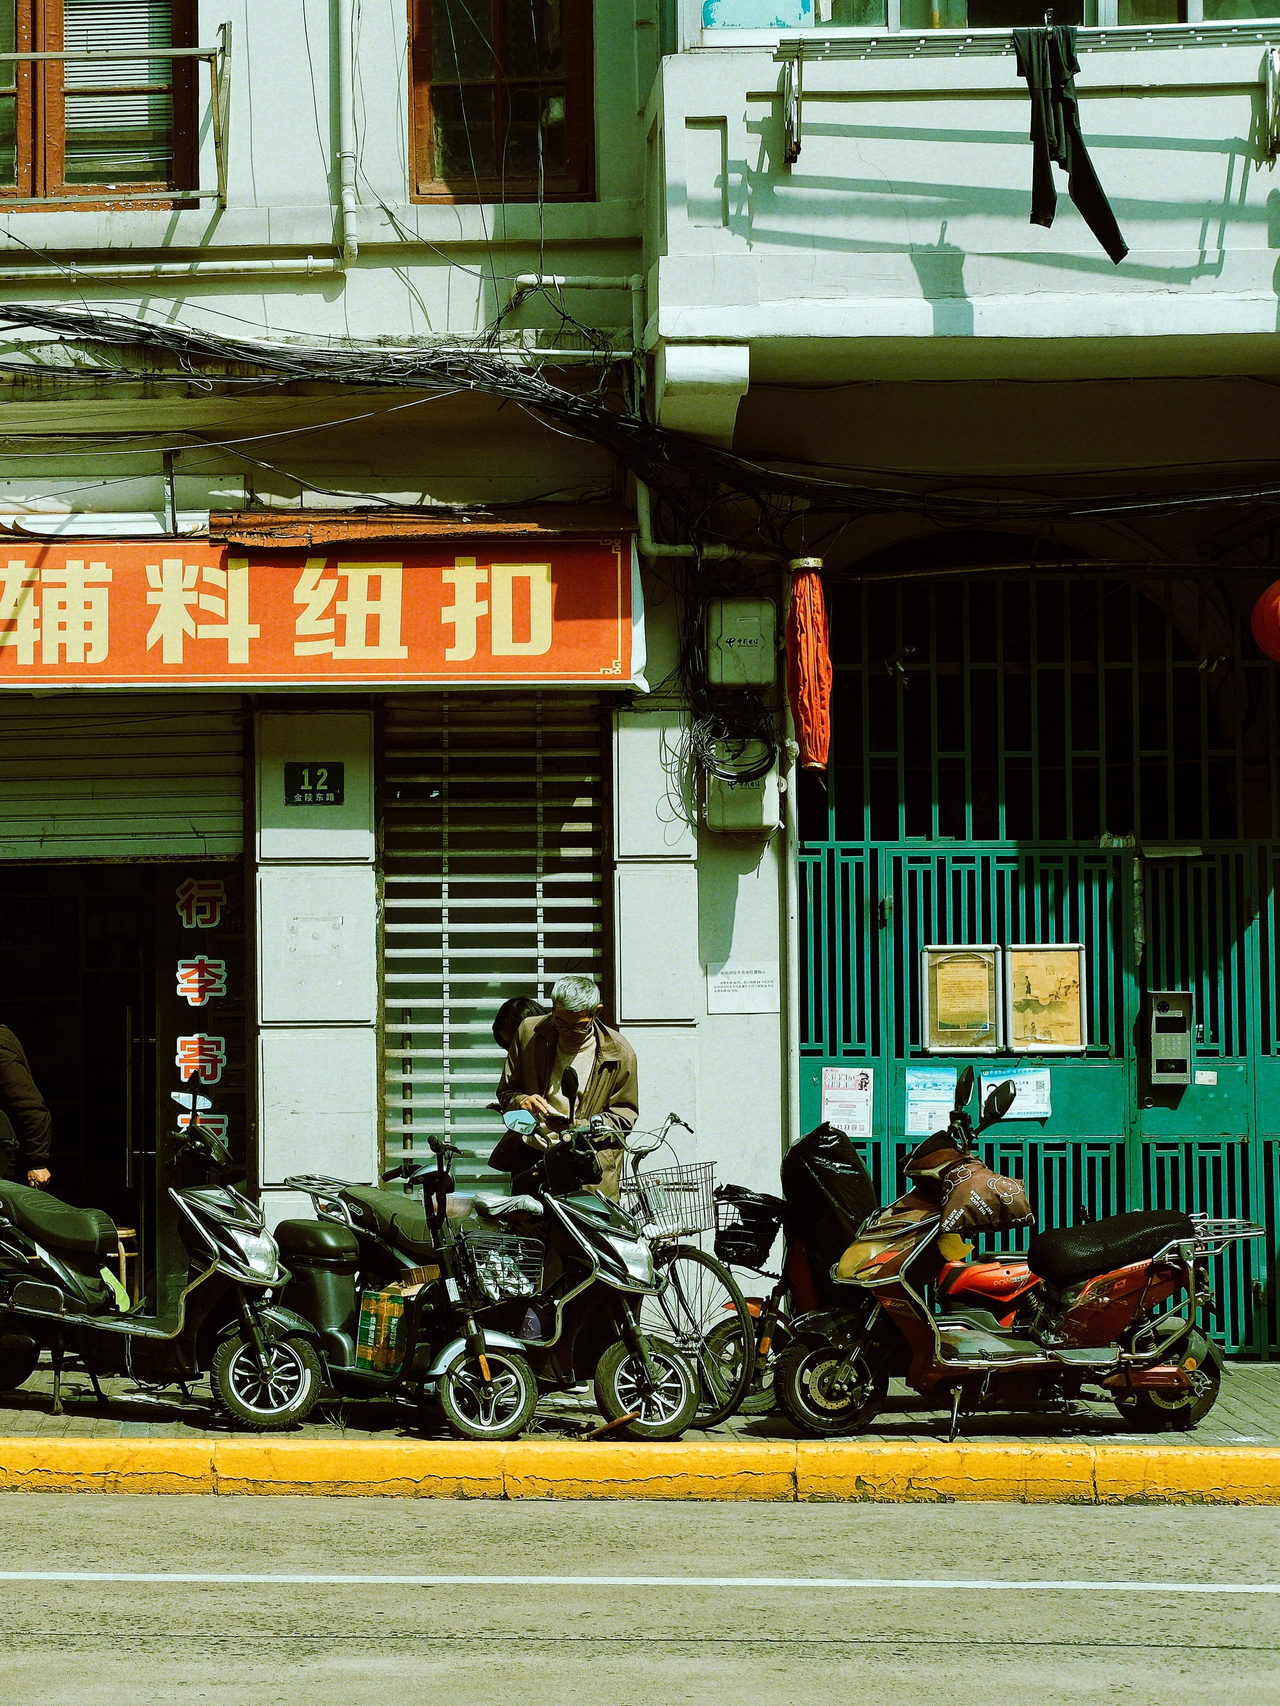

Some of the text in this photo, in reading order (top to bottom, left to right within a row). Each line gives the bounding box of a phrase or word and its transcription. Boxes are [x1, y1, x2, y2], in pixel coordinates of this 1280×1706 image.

[301, 768, 328, 790] 12
[294, 793, 335, 802] 金陵东路
